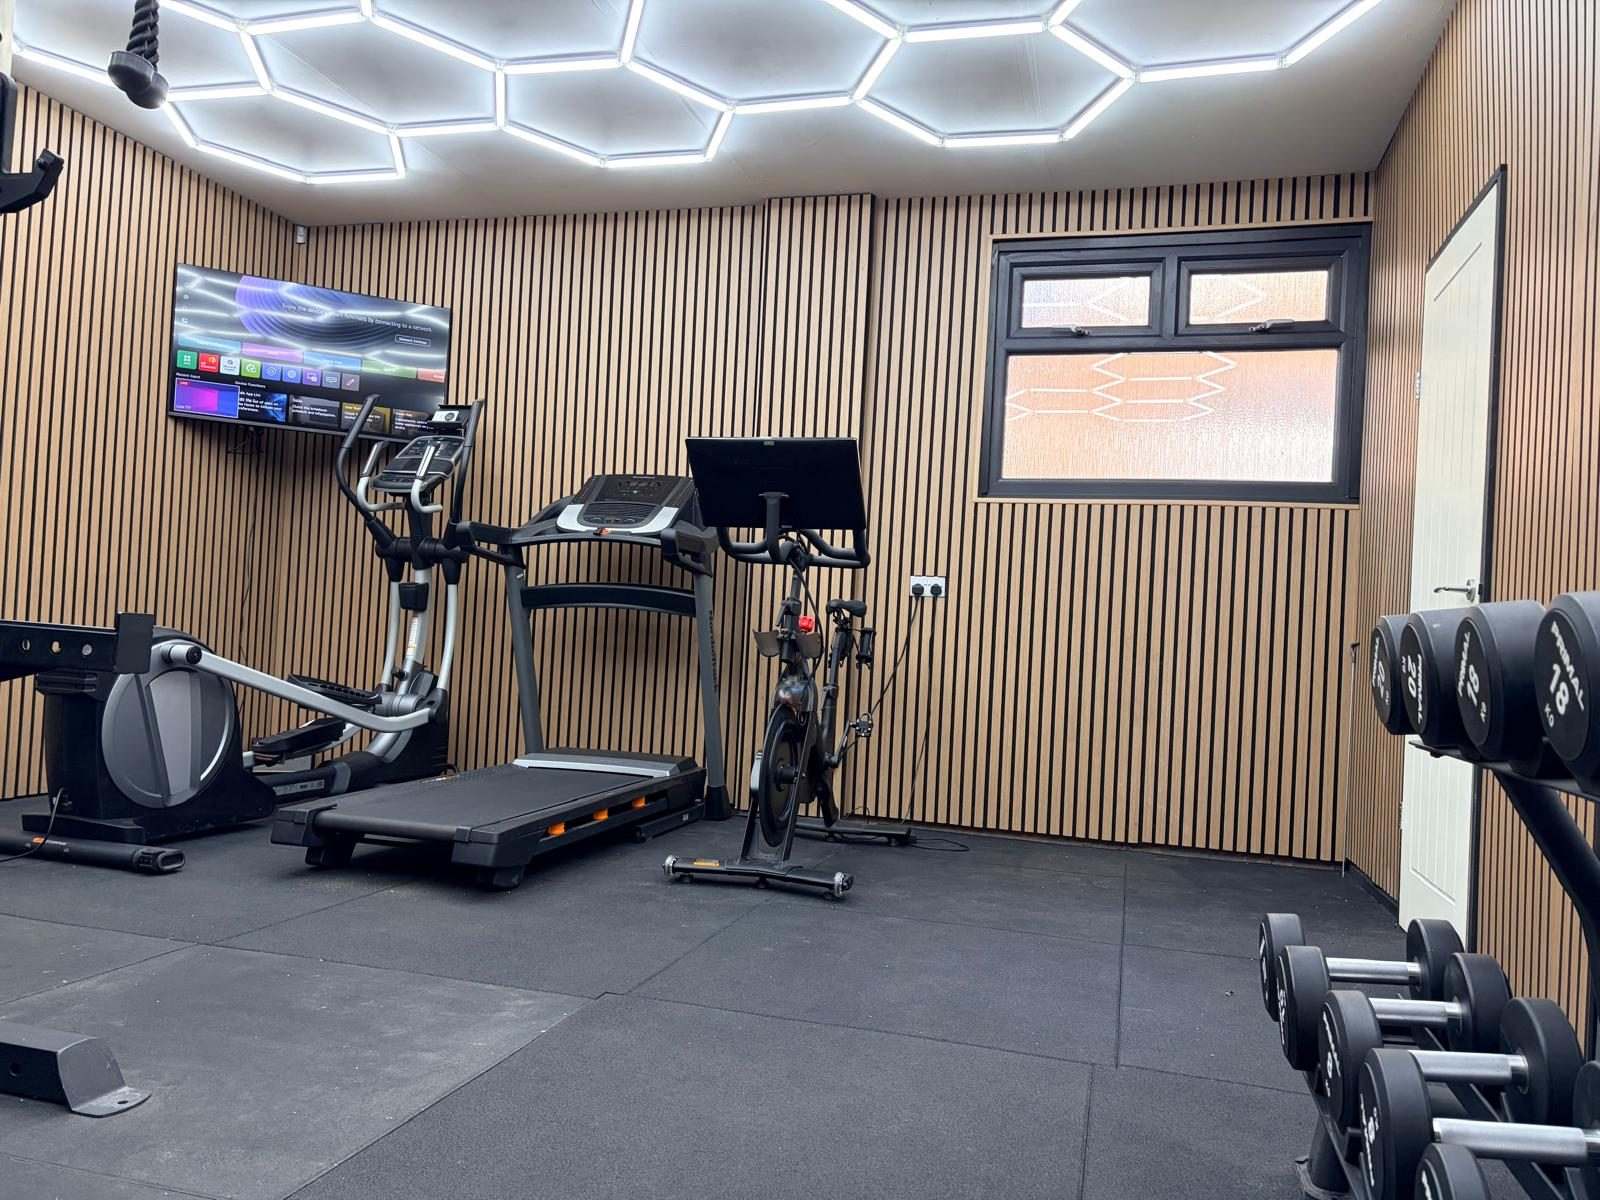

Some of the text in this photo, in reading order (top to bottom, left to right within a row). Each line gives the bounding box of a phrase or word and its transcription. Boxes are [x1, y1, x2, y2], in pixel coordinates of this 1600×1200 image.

[1408, 655, 1417, 698] 20
[1467, 664, 1479, 707] 18
[1550, 663, 1569, 715] 18
